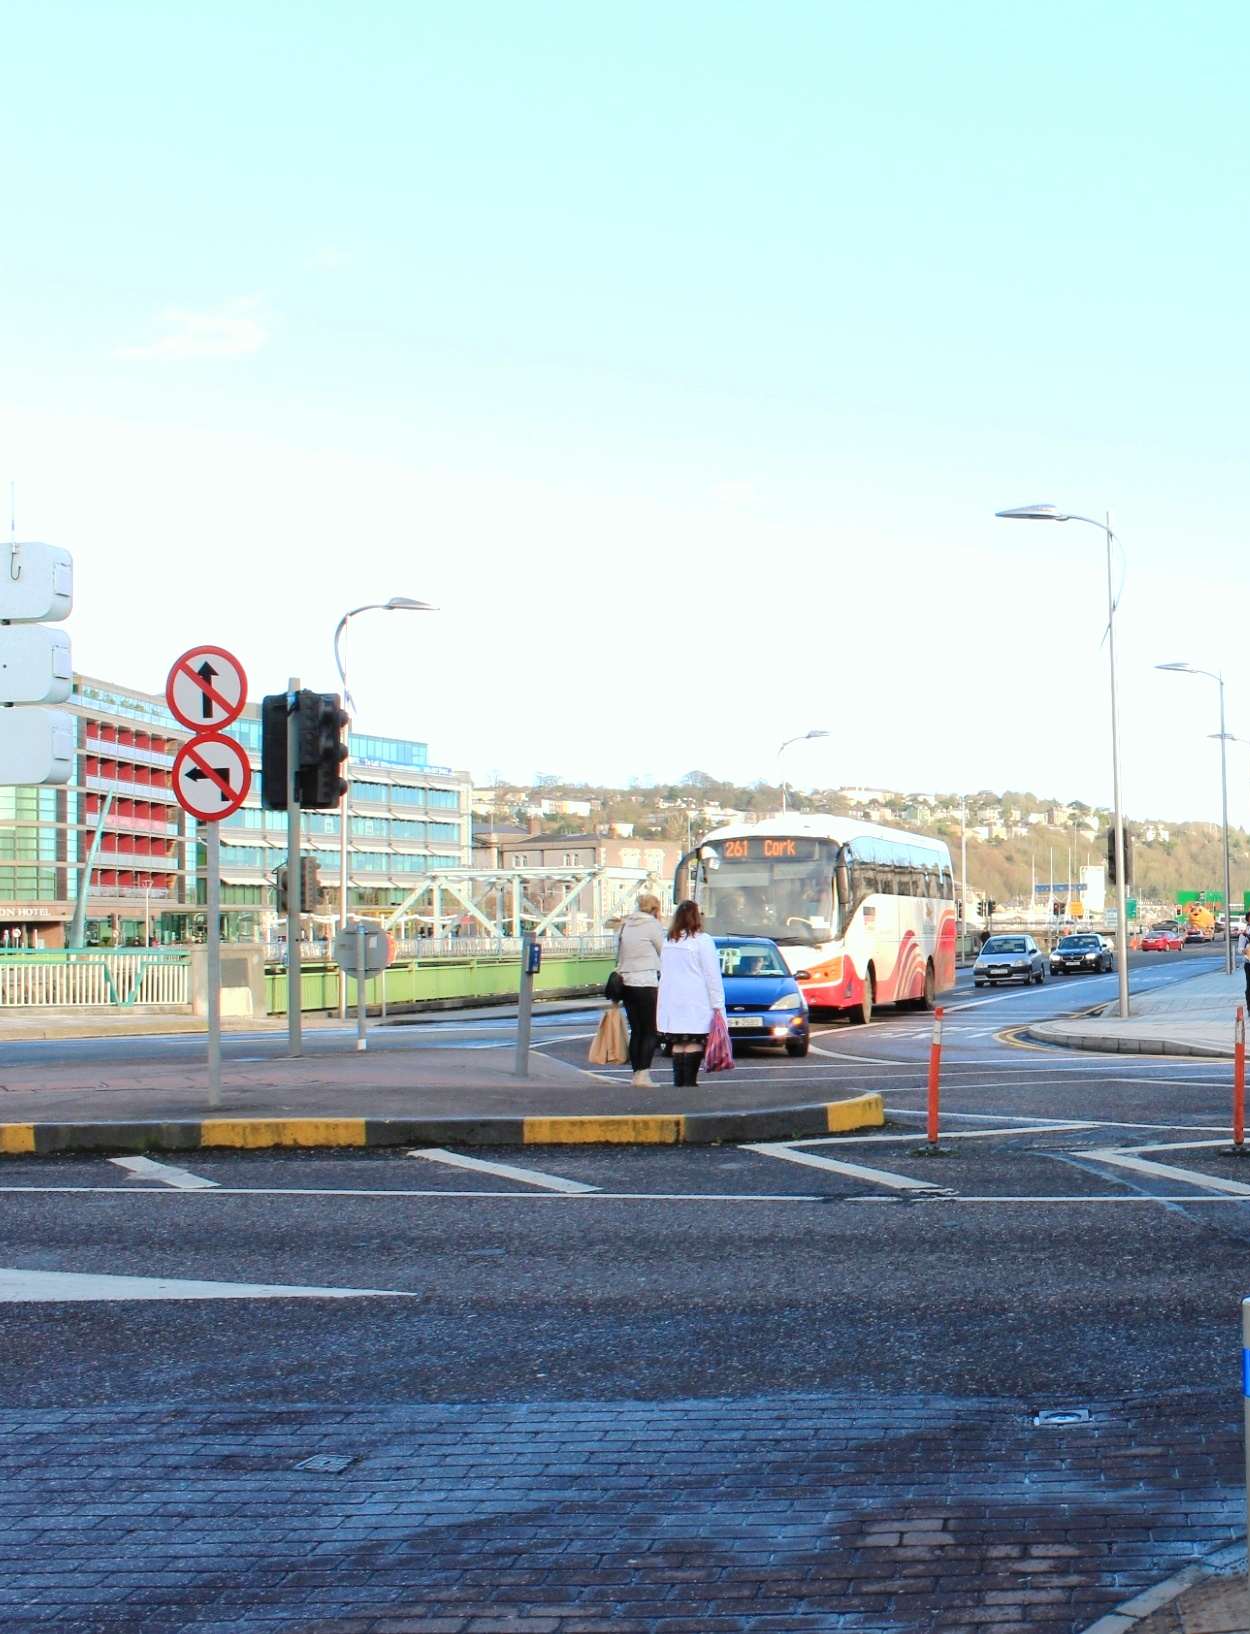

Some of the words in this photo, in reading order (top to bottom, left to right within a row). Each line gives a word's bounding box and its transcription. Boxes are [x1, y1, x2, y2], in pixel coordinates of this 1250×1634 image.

[725, 841, 748, 857] 261
[764, 839, 797, 856] Cork
[17, 908, 50, 917] HOTEL
